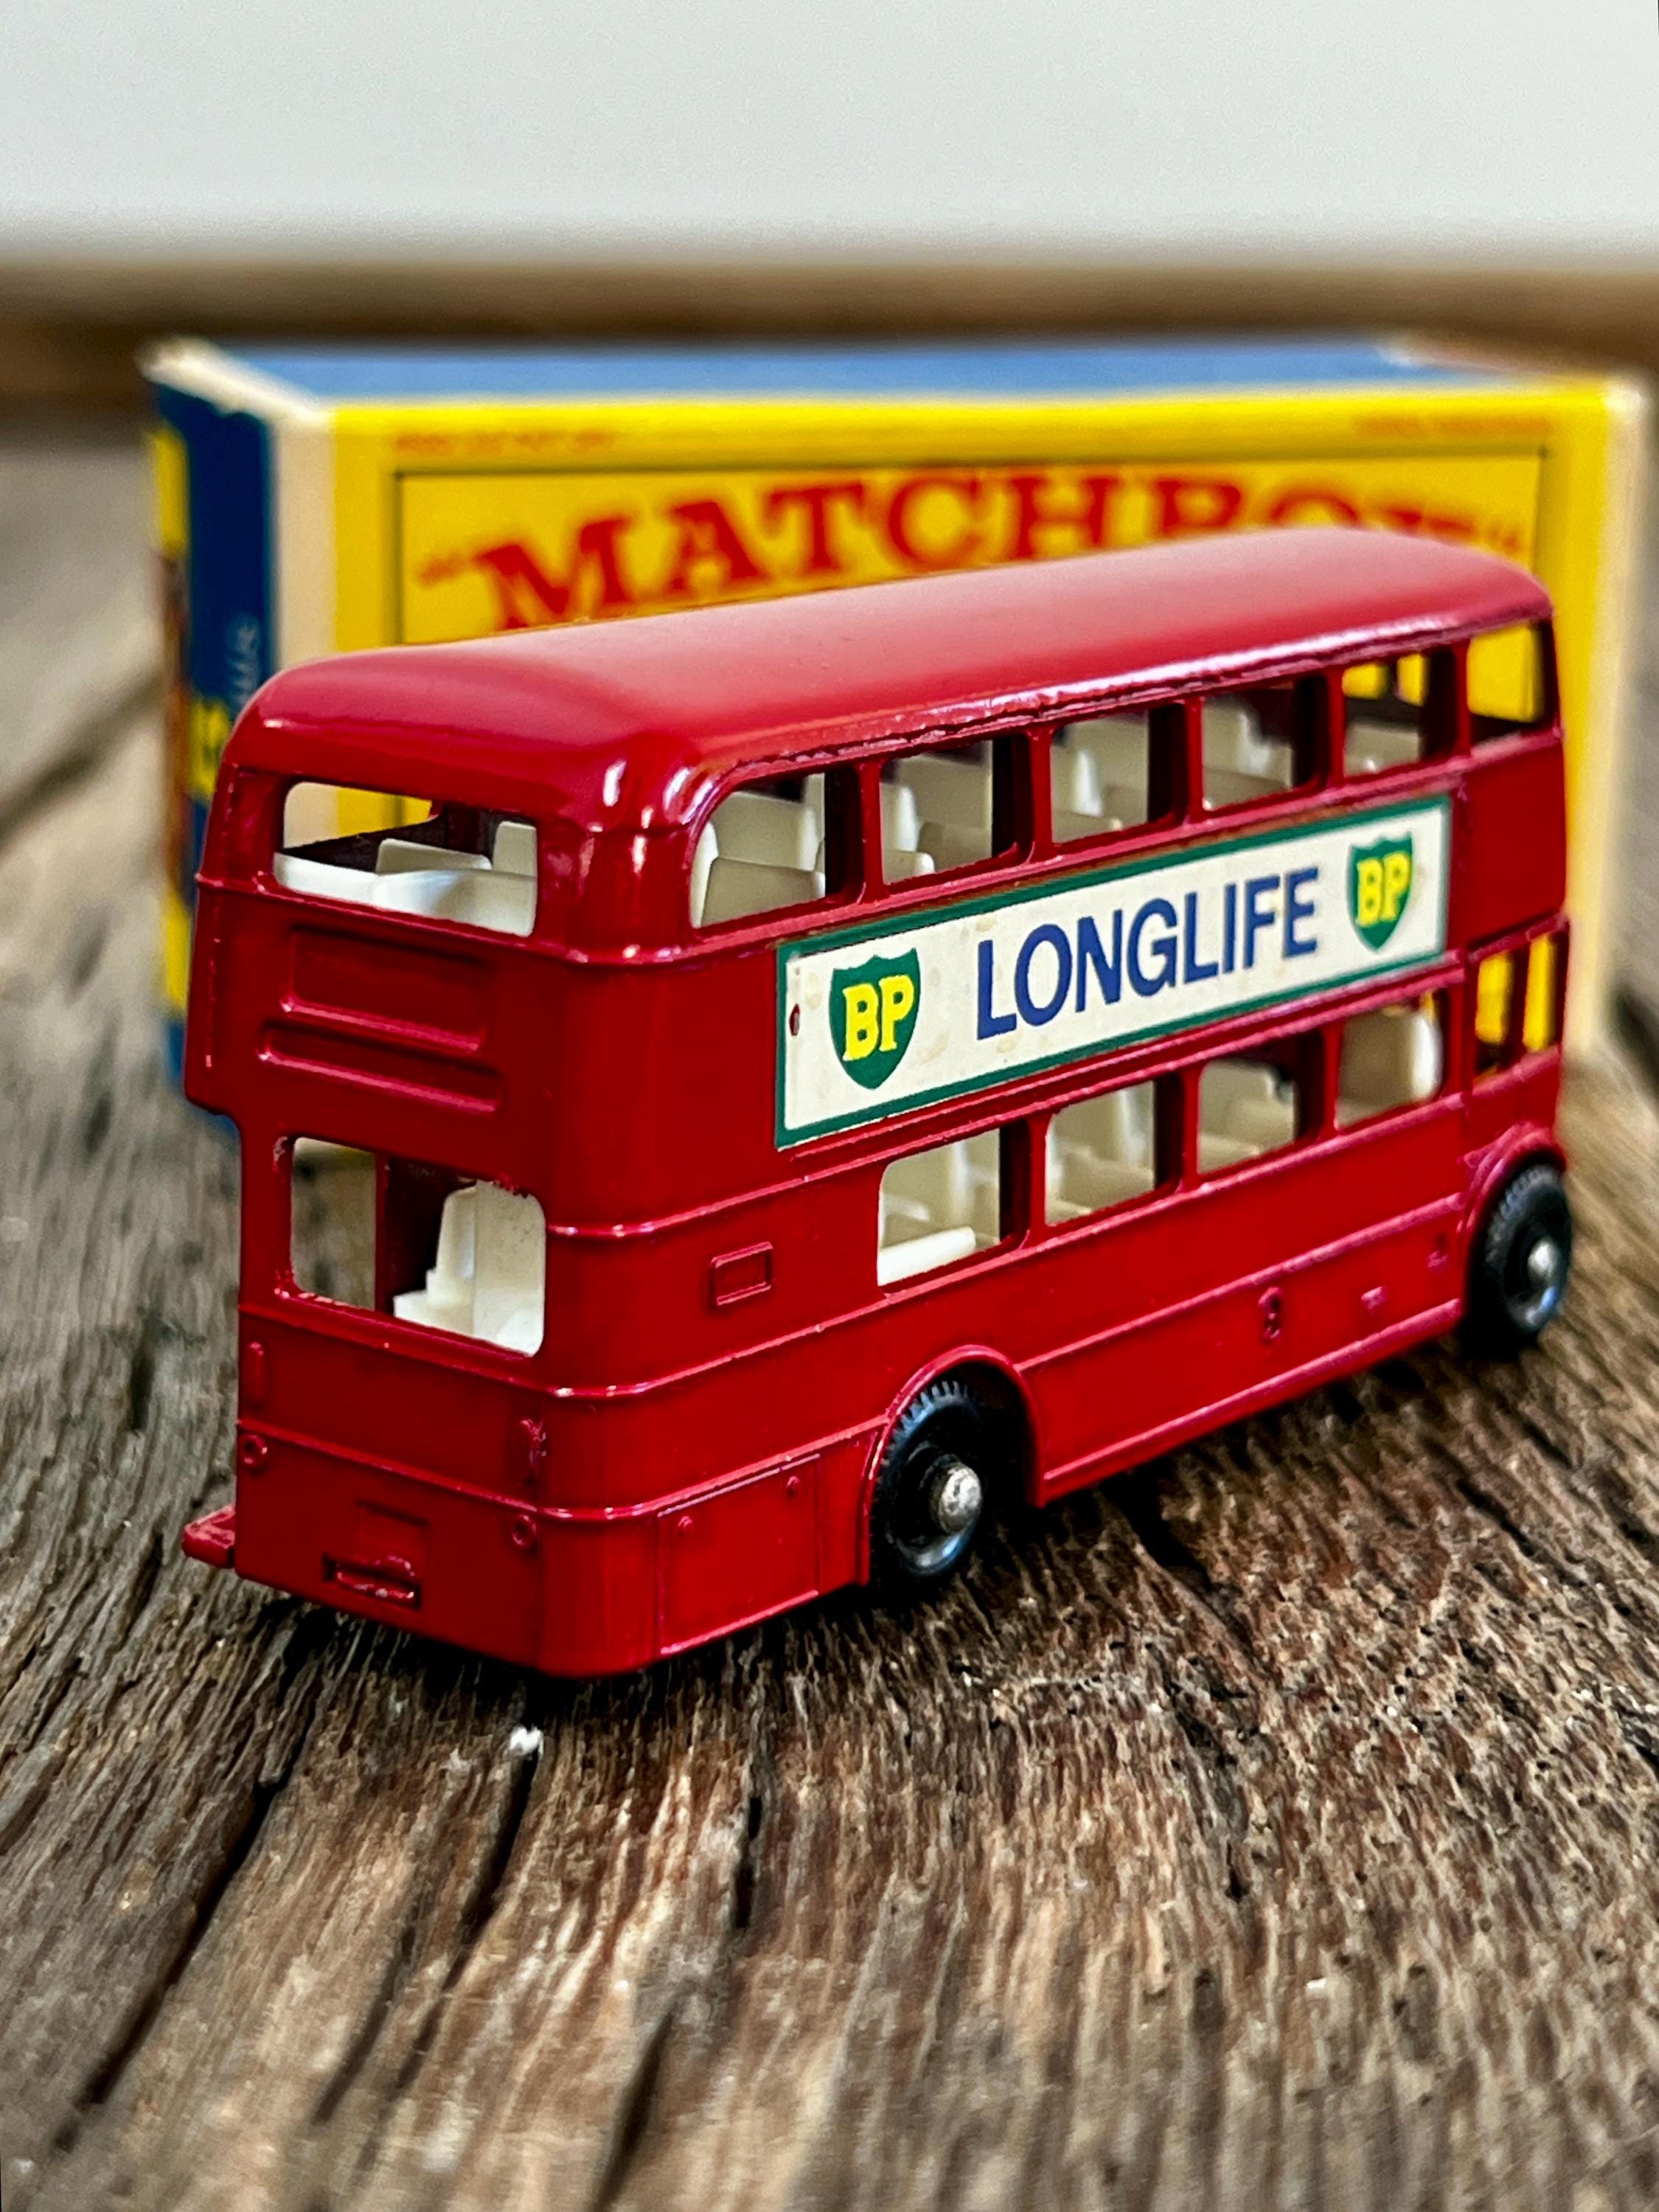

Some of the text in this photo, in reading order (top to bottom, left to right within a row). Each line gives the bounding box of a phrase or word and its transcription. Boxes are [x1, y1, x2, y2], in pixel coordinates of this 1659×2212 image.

[842, 849, 1411, 1062] BP LONGLIFE BP
